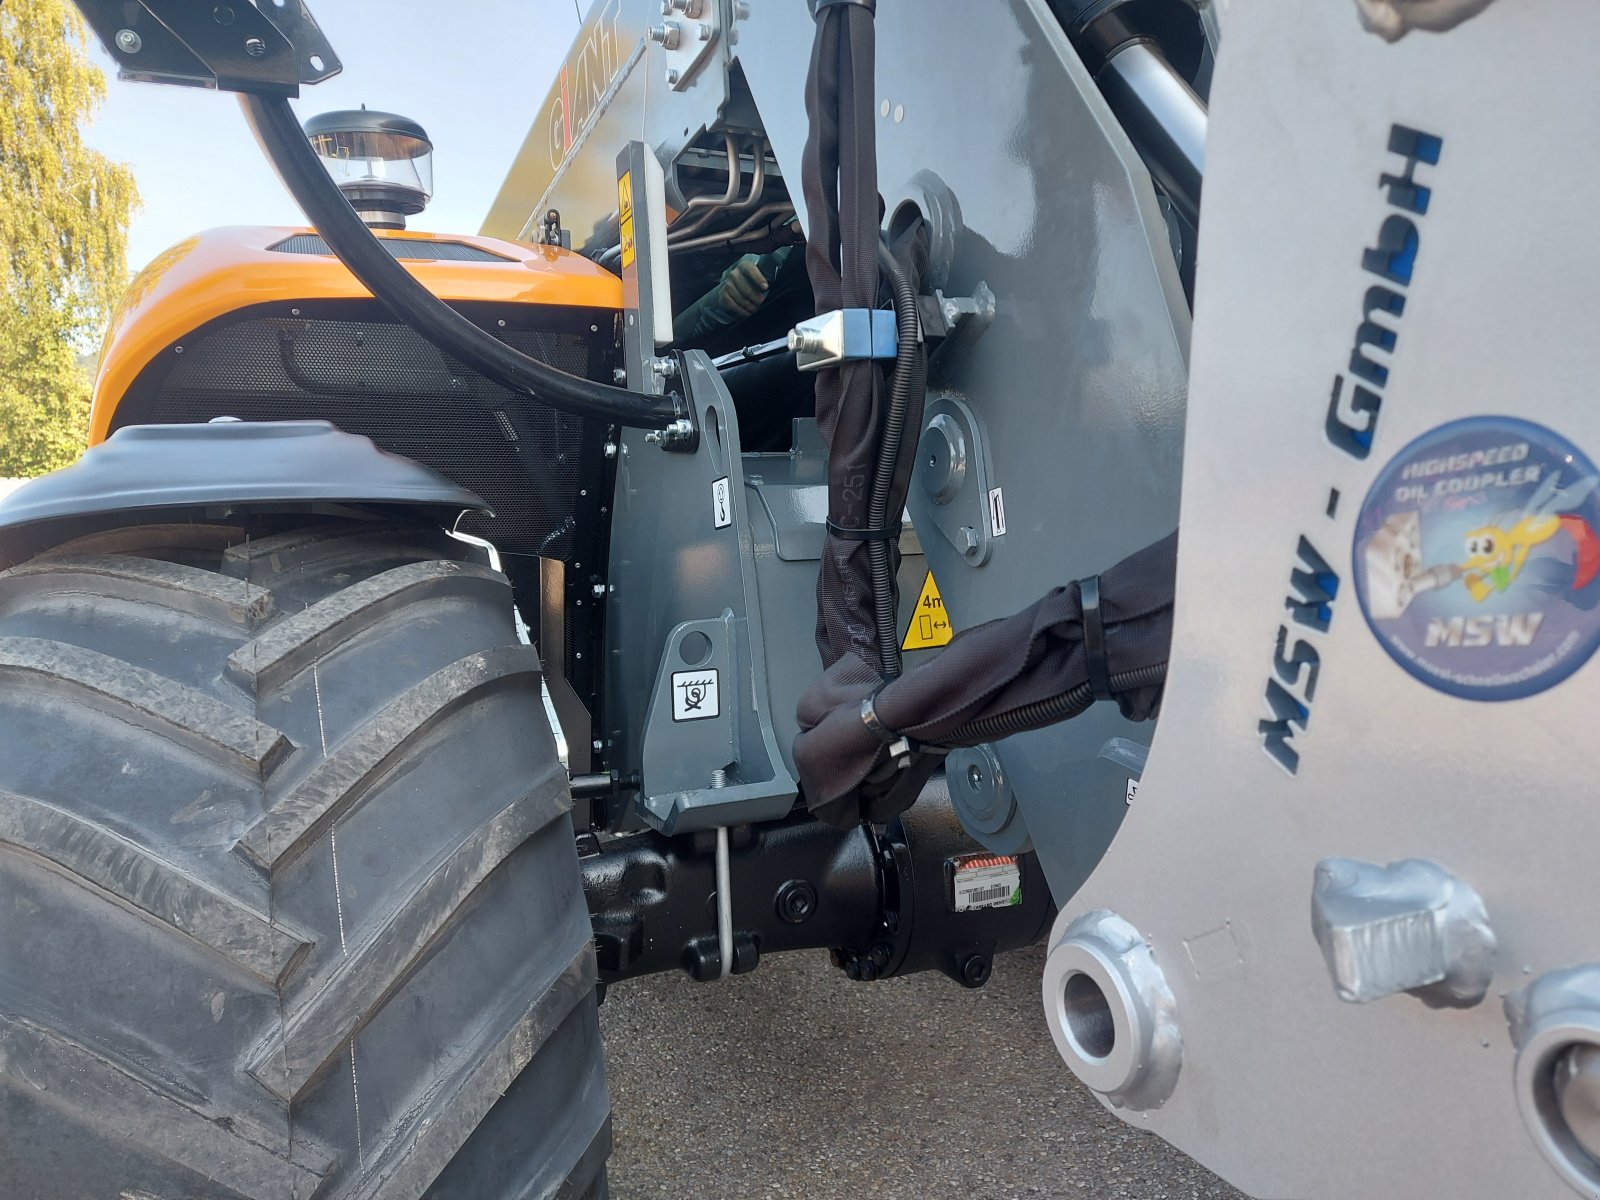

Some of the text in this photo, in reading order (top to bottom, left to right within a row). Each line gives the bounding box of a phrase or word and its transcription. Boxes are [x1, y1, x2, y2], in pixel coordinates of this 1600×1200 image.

[1258, 534, 1340, 777] MSW
[1325, 123, 1443, 461] GmbH
[1402, 443, 1529, 480] HIGHSPEED
[1395, 464, 1542, 502] OIL COUPLER
[1424, 612, 1545, 648] MSW
